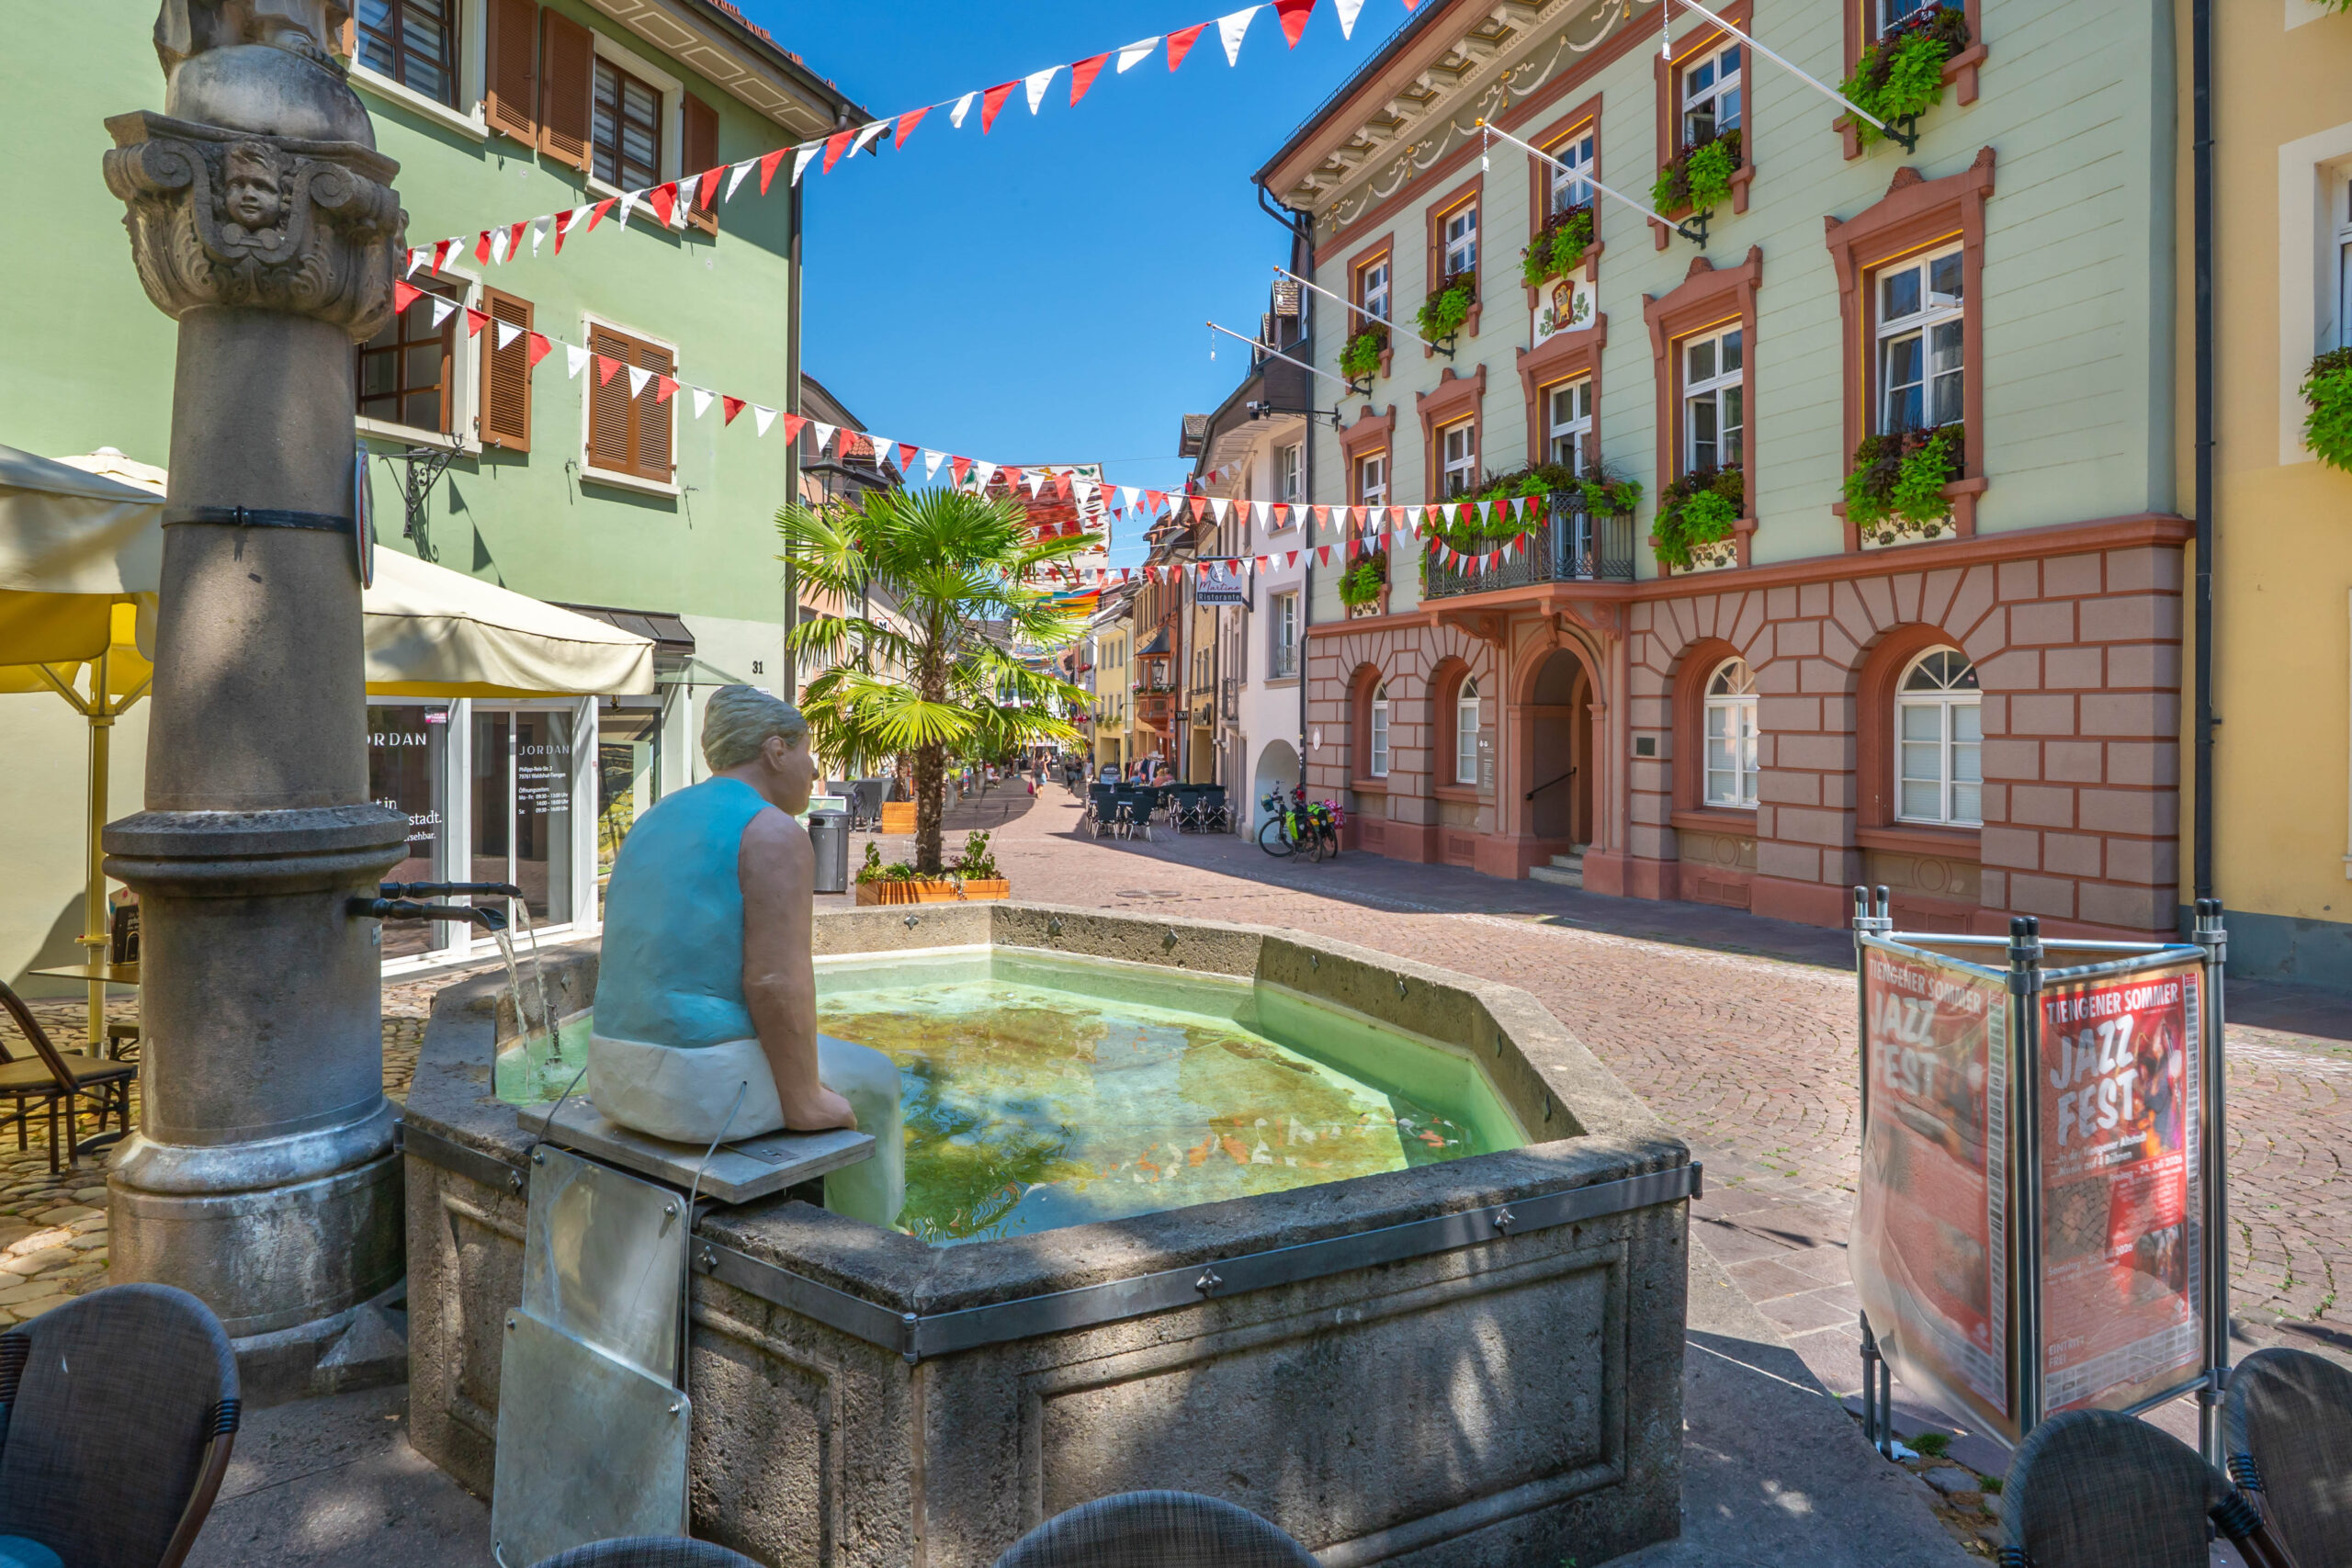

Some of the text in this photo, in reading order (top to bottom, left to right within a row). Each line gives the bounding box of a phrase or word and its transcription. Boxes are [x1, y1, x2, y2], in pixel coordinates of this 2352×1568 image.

[752, 660, 763, 674] 31
[368, 732, 426, 746] RDAN
[518, 745, 570, 756] JORDAN
[384, 797, 397, 809] in
[1869, 959, 1982, 1014] TIENGENER SOMMER
[2046, 983, 2178, 1024] TIENGENER SOMMER
[1870, 990, 1936, 1046] JAZZ
[2050, 1013, 2134, 1089] JAZZ
[1871, 1040, 1939, 1099] FEST
[2057, 1068, 2139, 1146] FEST
[2085, 1157, 2098, 1170] auf
[2116, 1243, 2133, 1256] 2026
[2049, 1335, 2085, 1356] EINTRITT
[2049, 1354, 2066, 1368] FREI
